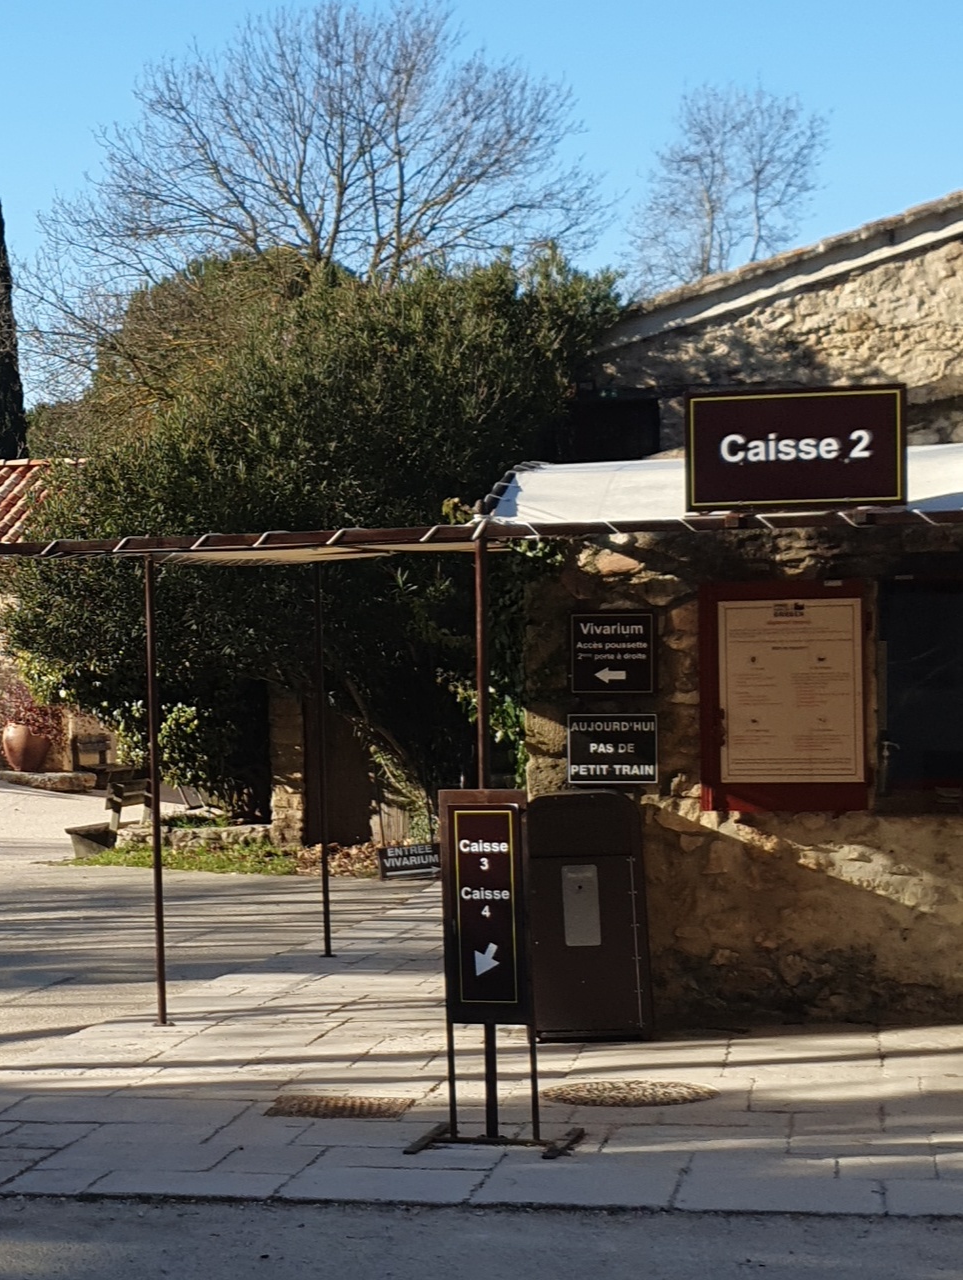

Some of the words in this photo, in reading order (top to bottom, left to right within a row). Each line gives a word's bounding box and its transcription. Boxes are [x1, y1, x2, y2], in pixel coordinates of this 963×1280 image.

[720, 432, 840, 463] Caisse
[849, 430, 872, 458] 2
[579, 622, 644, 635] Vivarium
[576, 641, 603, 649] Accès
[605, 642, 648, 650] poussette
[616, 652, 622, 660] à
[623, 652, 647, 660] droite
[570, 721, 655, 731] AUJOURD'HUI
[589, 743, 614, 753] PAS
[618, 743, 635, 753] DE
[571, 764, 609, 775] PETIT
[613, 764, 654, 775] TRAIN
[459, 839, 509, 852] Caisse
[383, 854, 439, 868] VIVARIUM
[479, 857, 489, 870] 3
[461, 886, 510, 900] Caisse
[481, 904, 491, 918] 4
